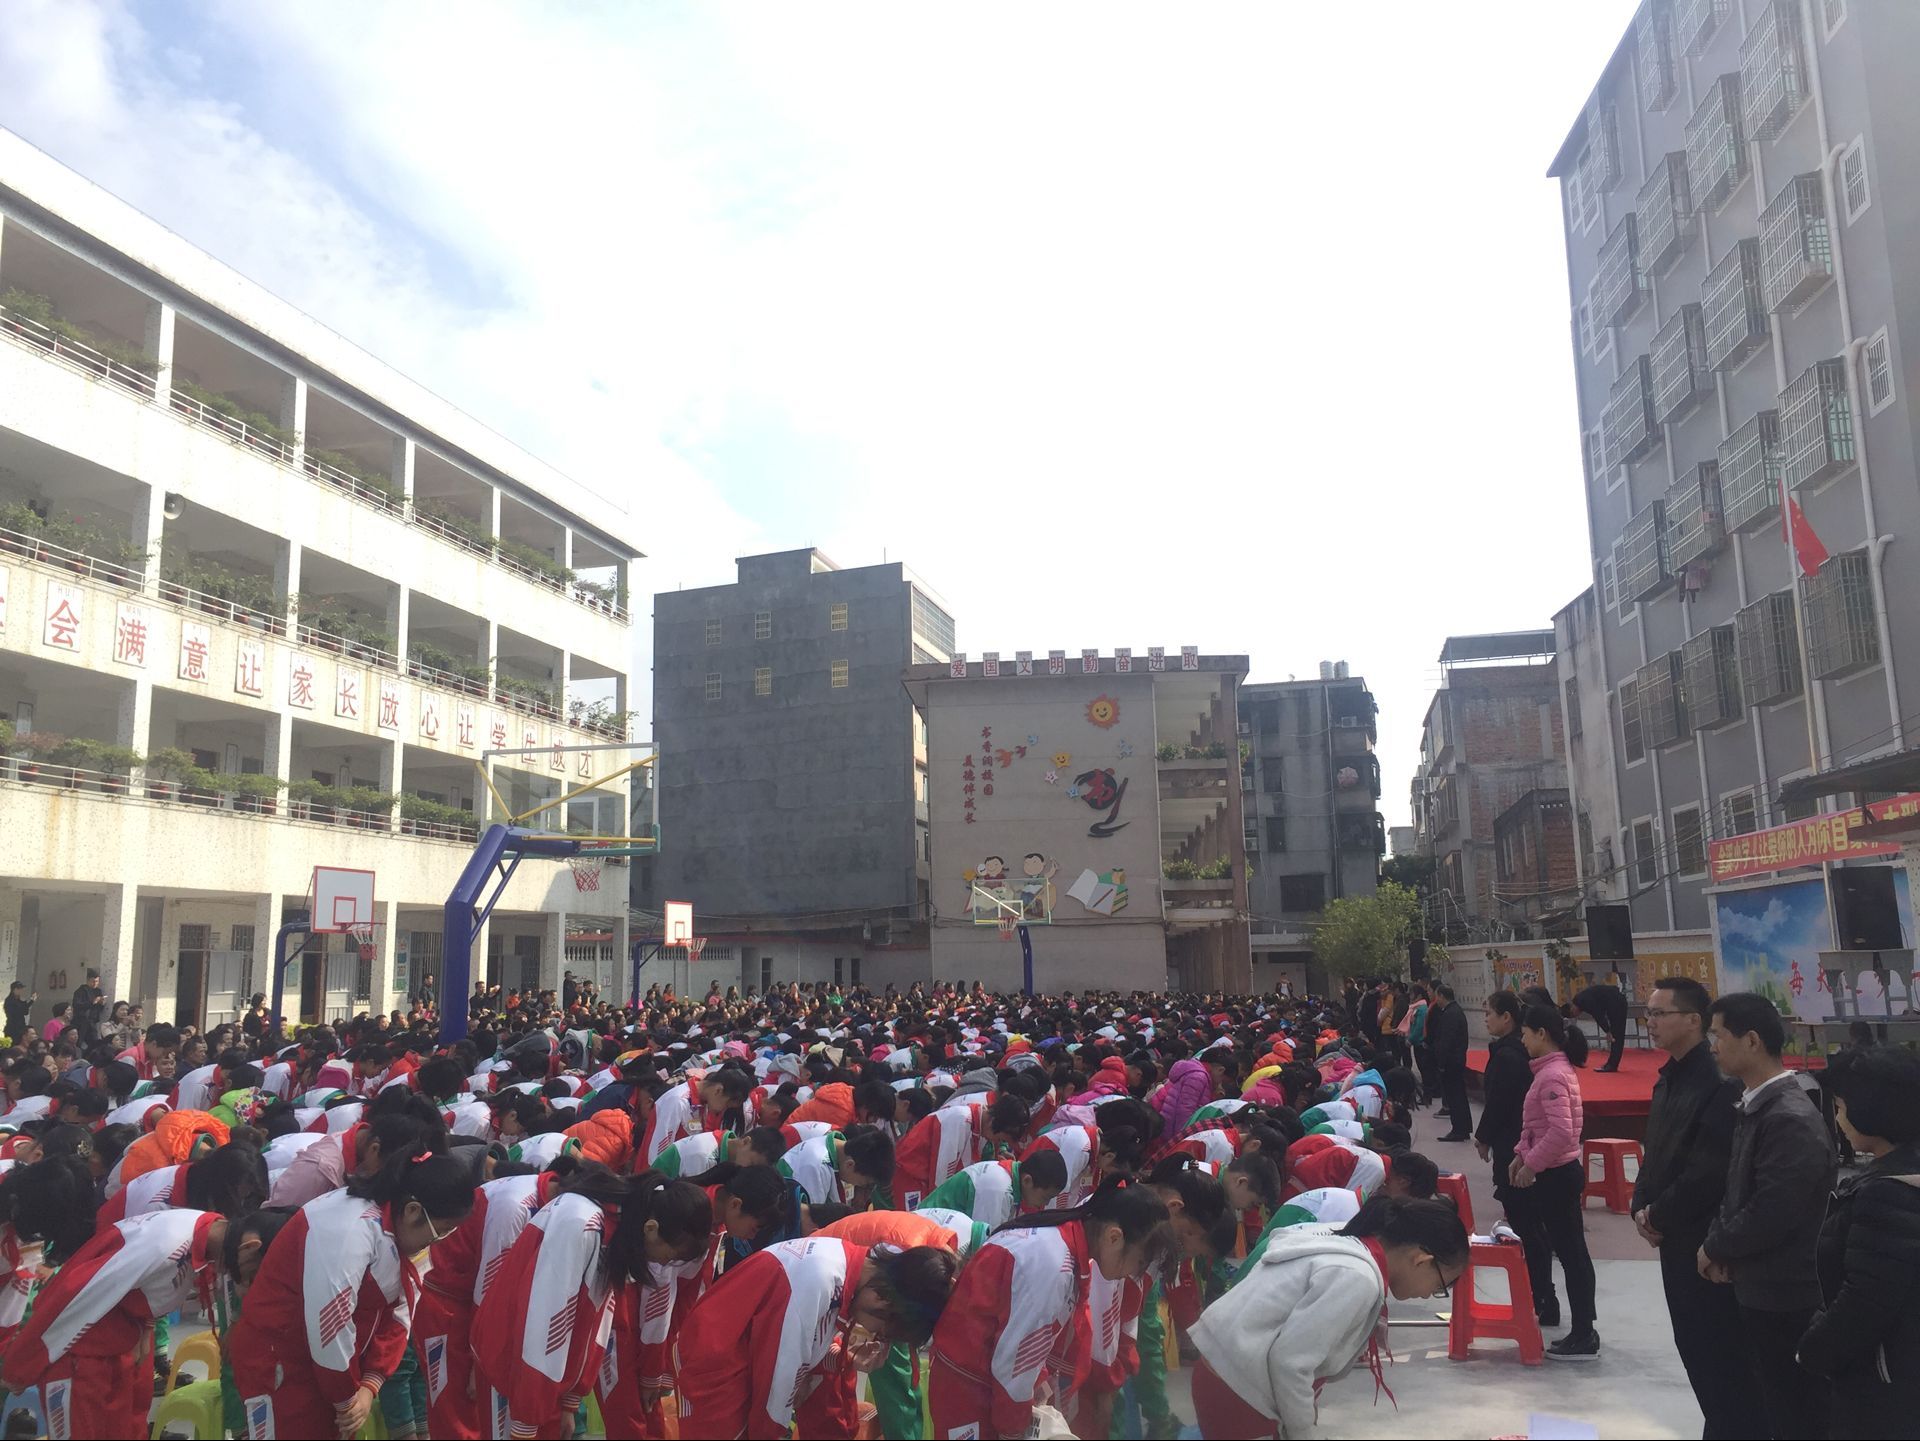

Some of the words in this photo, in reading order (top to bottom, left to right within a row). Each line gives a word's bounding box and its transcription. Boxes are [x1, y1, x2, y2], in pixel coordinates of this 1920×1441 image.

[951, 652, 1198, 677] 爱国文明勤奋进取
[980, 726, 995, 796] 书香润校园
